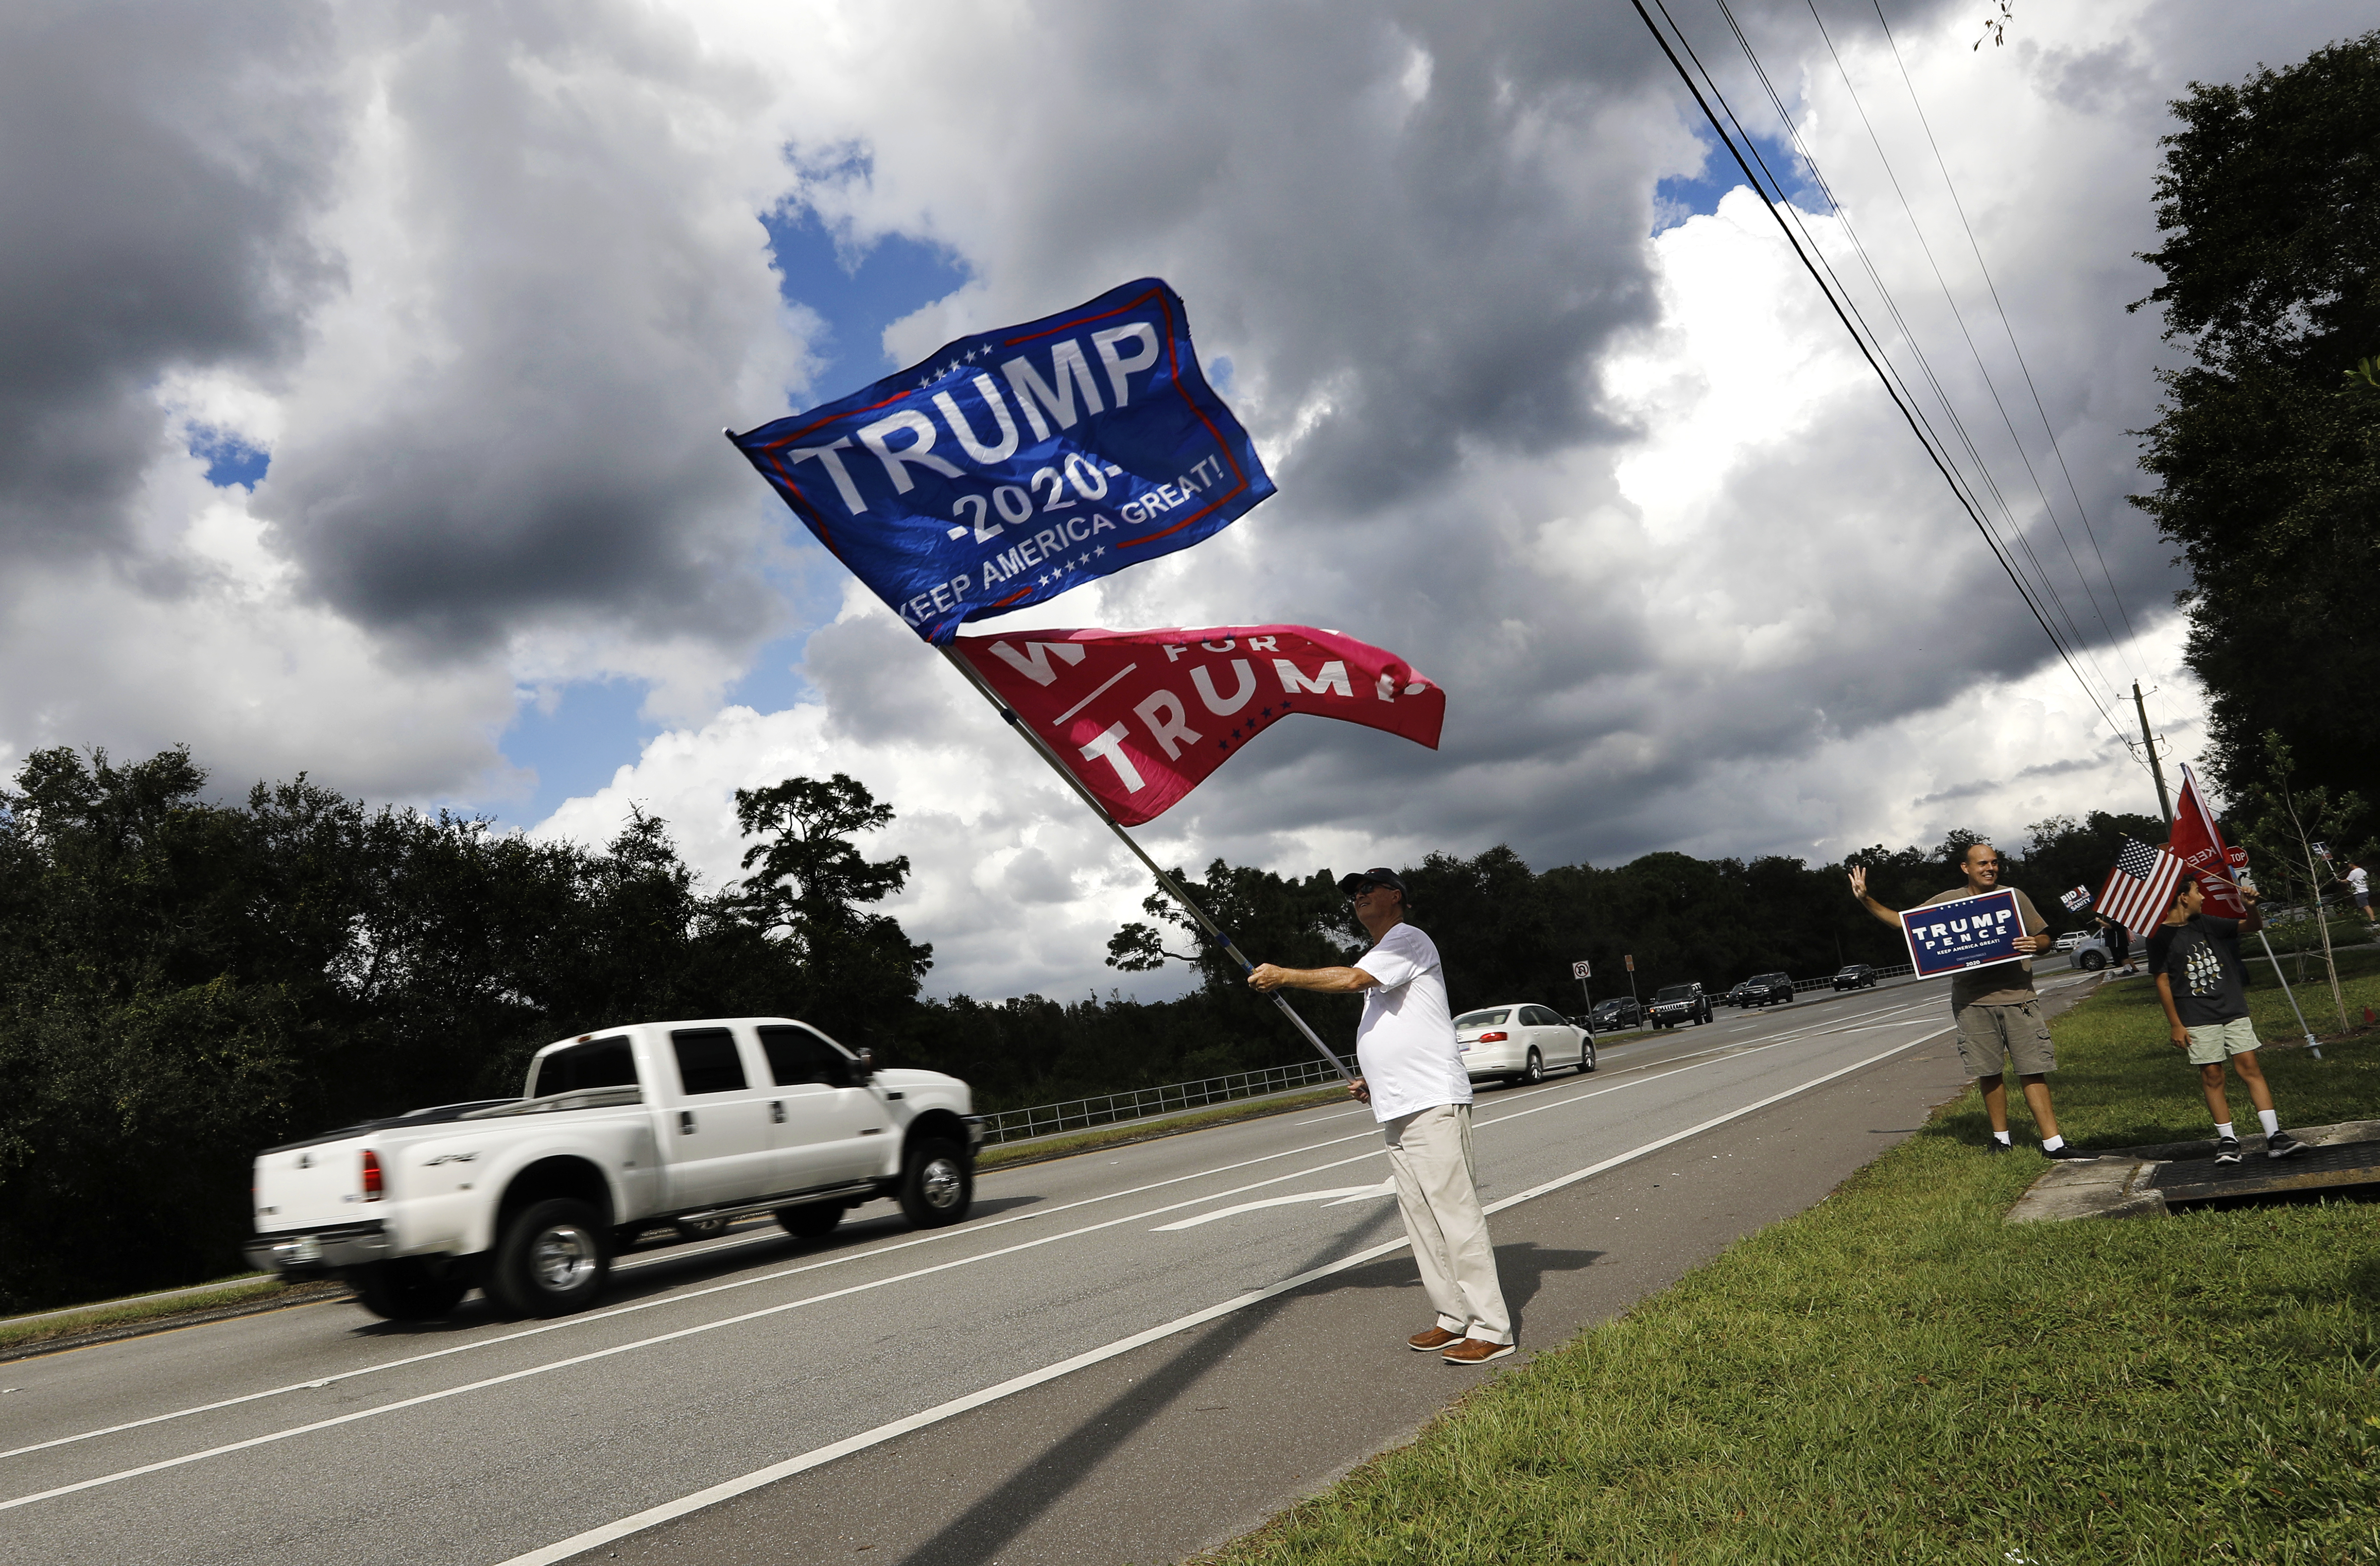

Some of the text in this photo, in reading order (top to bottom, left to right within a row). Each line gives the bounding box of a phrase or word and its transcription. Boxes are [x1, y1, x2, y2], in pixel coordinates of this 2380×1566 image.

[788, 321, 1159, 516] TRUMP
[982, 513, 1117, 590] AMERICA
[1120, 453, 1226, 525] GREAT!
[1162, 636, 1280, 662] FOR
[2230, 852, 2245, 863] TOP
[2060, 884, 2088, 904] BIDN
[2070, 897, 2091, 911] SANITY
[1912, 909, 2012, 940] TRUMP
[1926, 926, 2007, 950] PENCE
[1953, 943, 1979, 952] AMERICA
